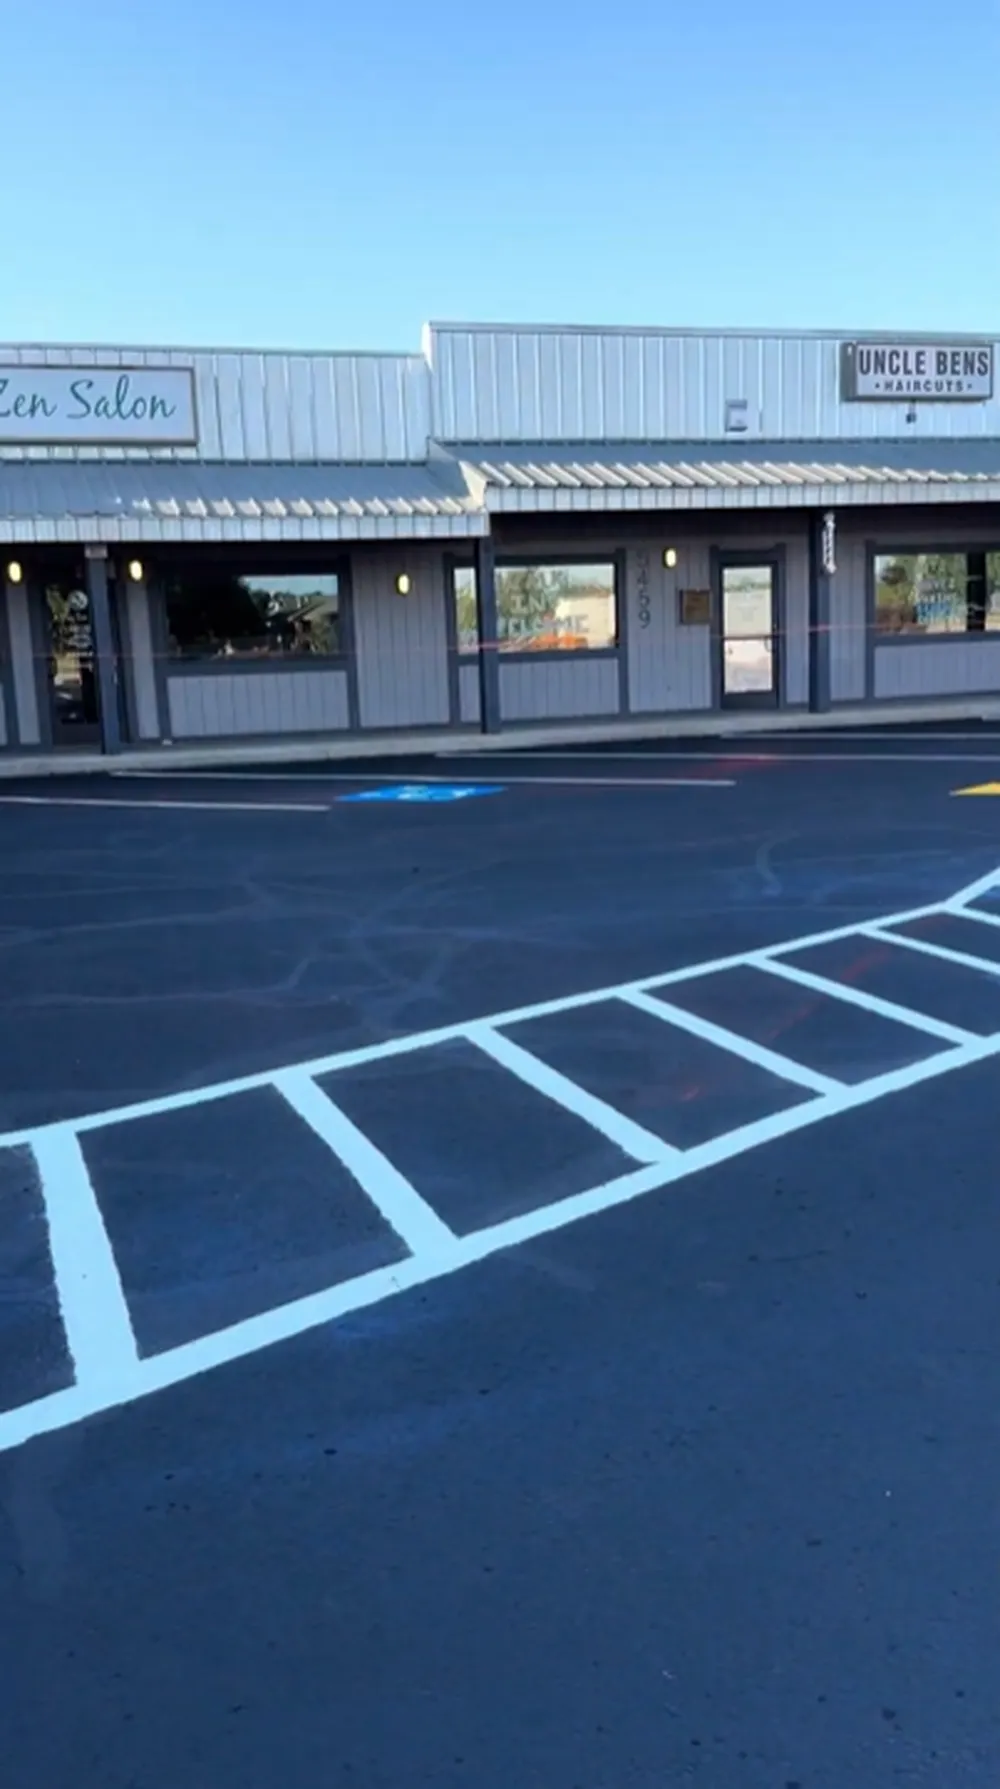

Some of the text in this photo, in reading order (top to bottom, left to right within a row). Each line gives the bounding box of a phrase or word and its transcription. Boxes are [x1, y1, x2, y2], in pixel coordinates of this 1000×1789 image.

[859, 349, 989, 377] UNCLE BENS
[66, 373, 177, 420] Salon
[883, 379, 965, 393] HAIRCUTS
